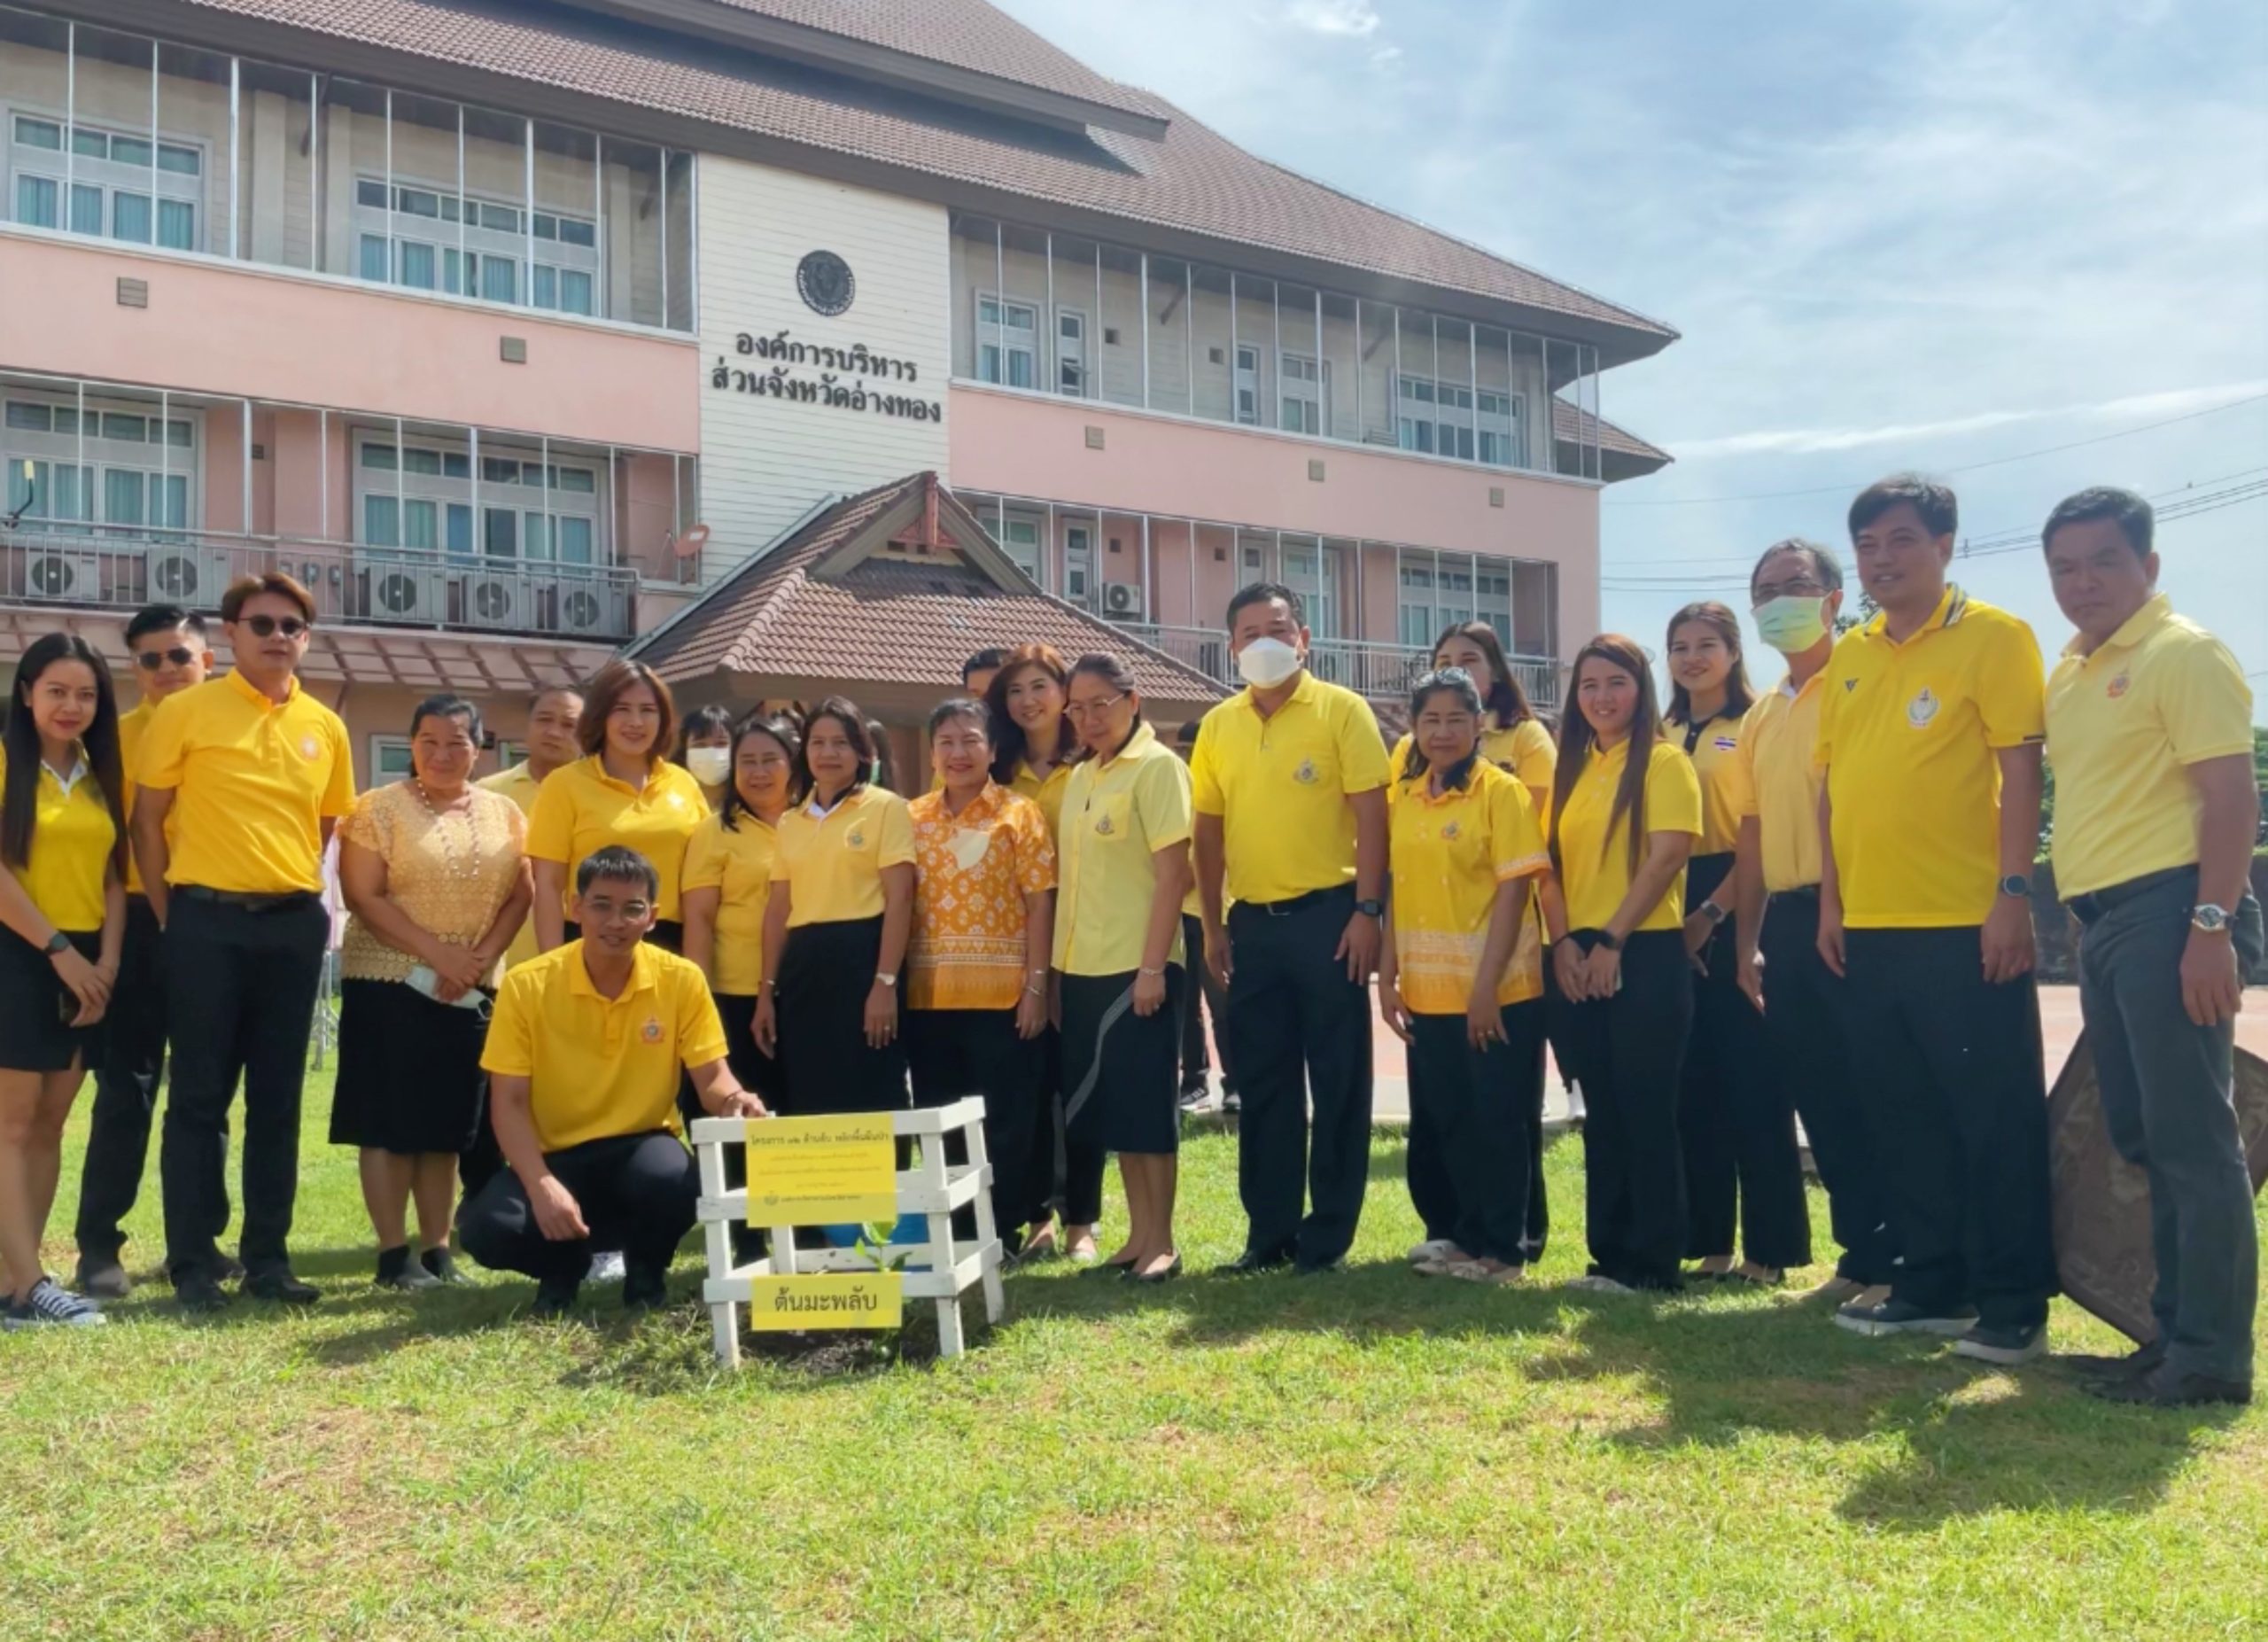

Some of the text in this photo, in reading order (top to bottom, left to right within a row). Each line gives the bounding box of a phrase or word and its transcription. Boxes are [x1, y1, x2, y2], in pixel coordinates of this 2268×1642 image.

[736, 330, 917, 382] องค์การบริหาร
[712, 357, 941, 423] ส่วนจังหวัดอ่างทอง
[774, 1285, 877, 1312] ต้นมะพลับ
